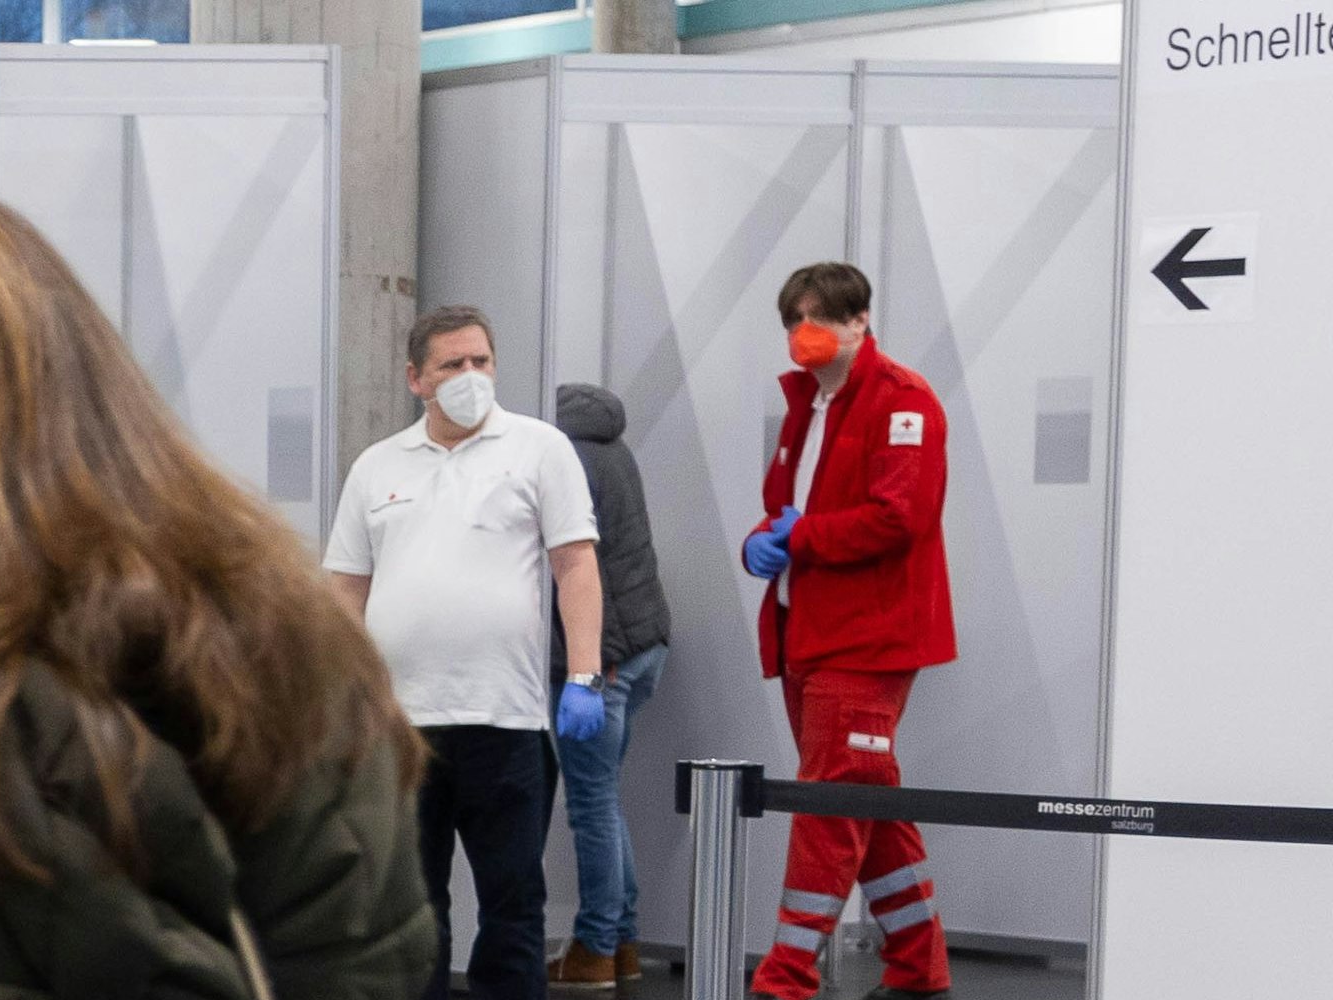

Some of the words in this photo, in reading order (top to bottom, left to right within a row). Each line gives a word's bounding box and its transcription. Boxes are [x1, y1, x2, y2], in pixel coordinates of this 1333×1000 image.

[1166, 12, 1333, 71] Schnellt
[1037, 801, 1154, 818] messezentrum
[1111, 820, 1154, 833] salzburg
